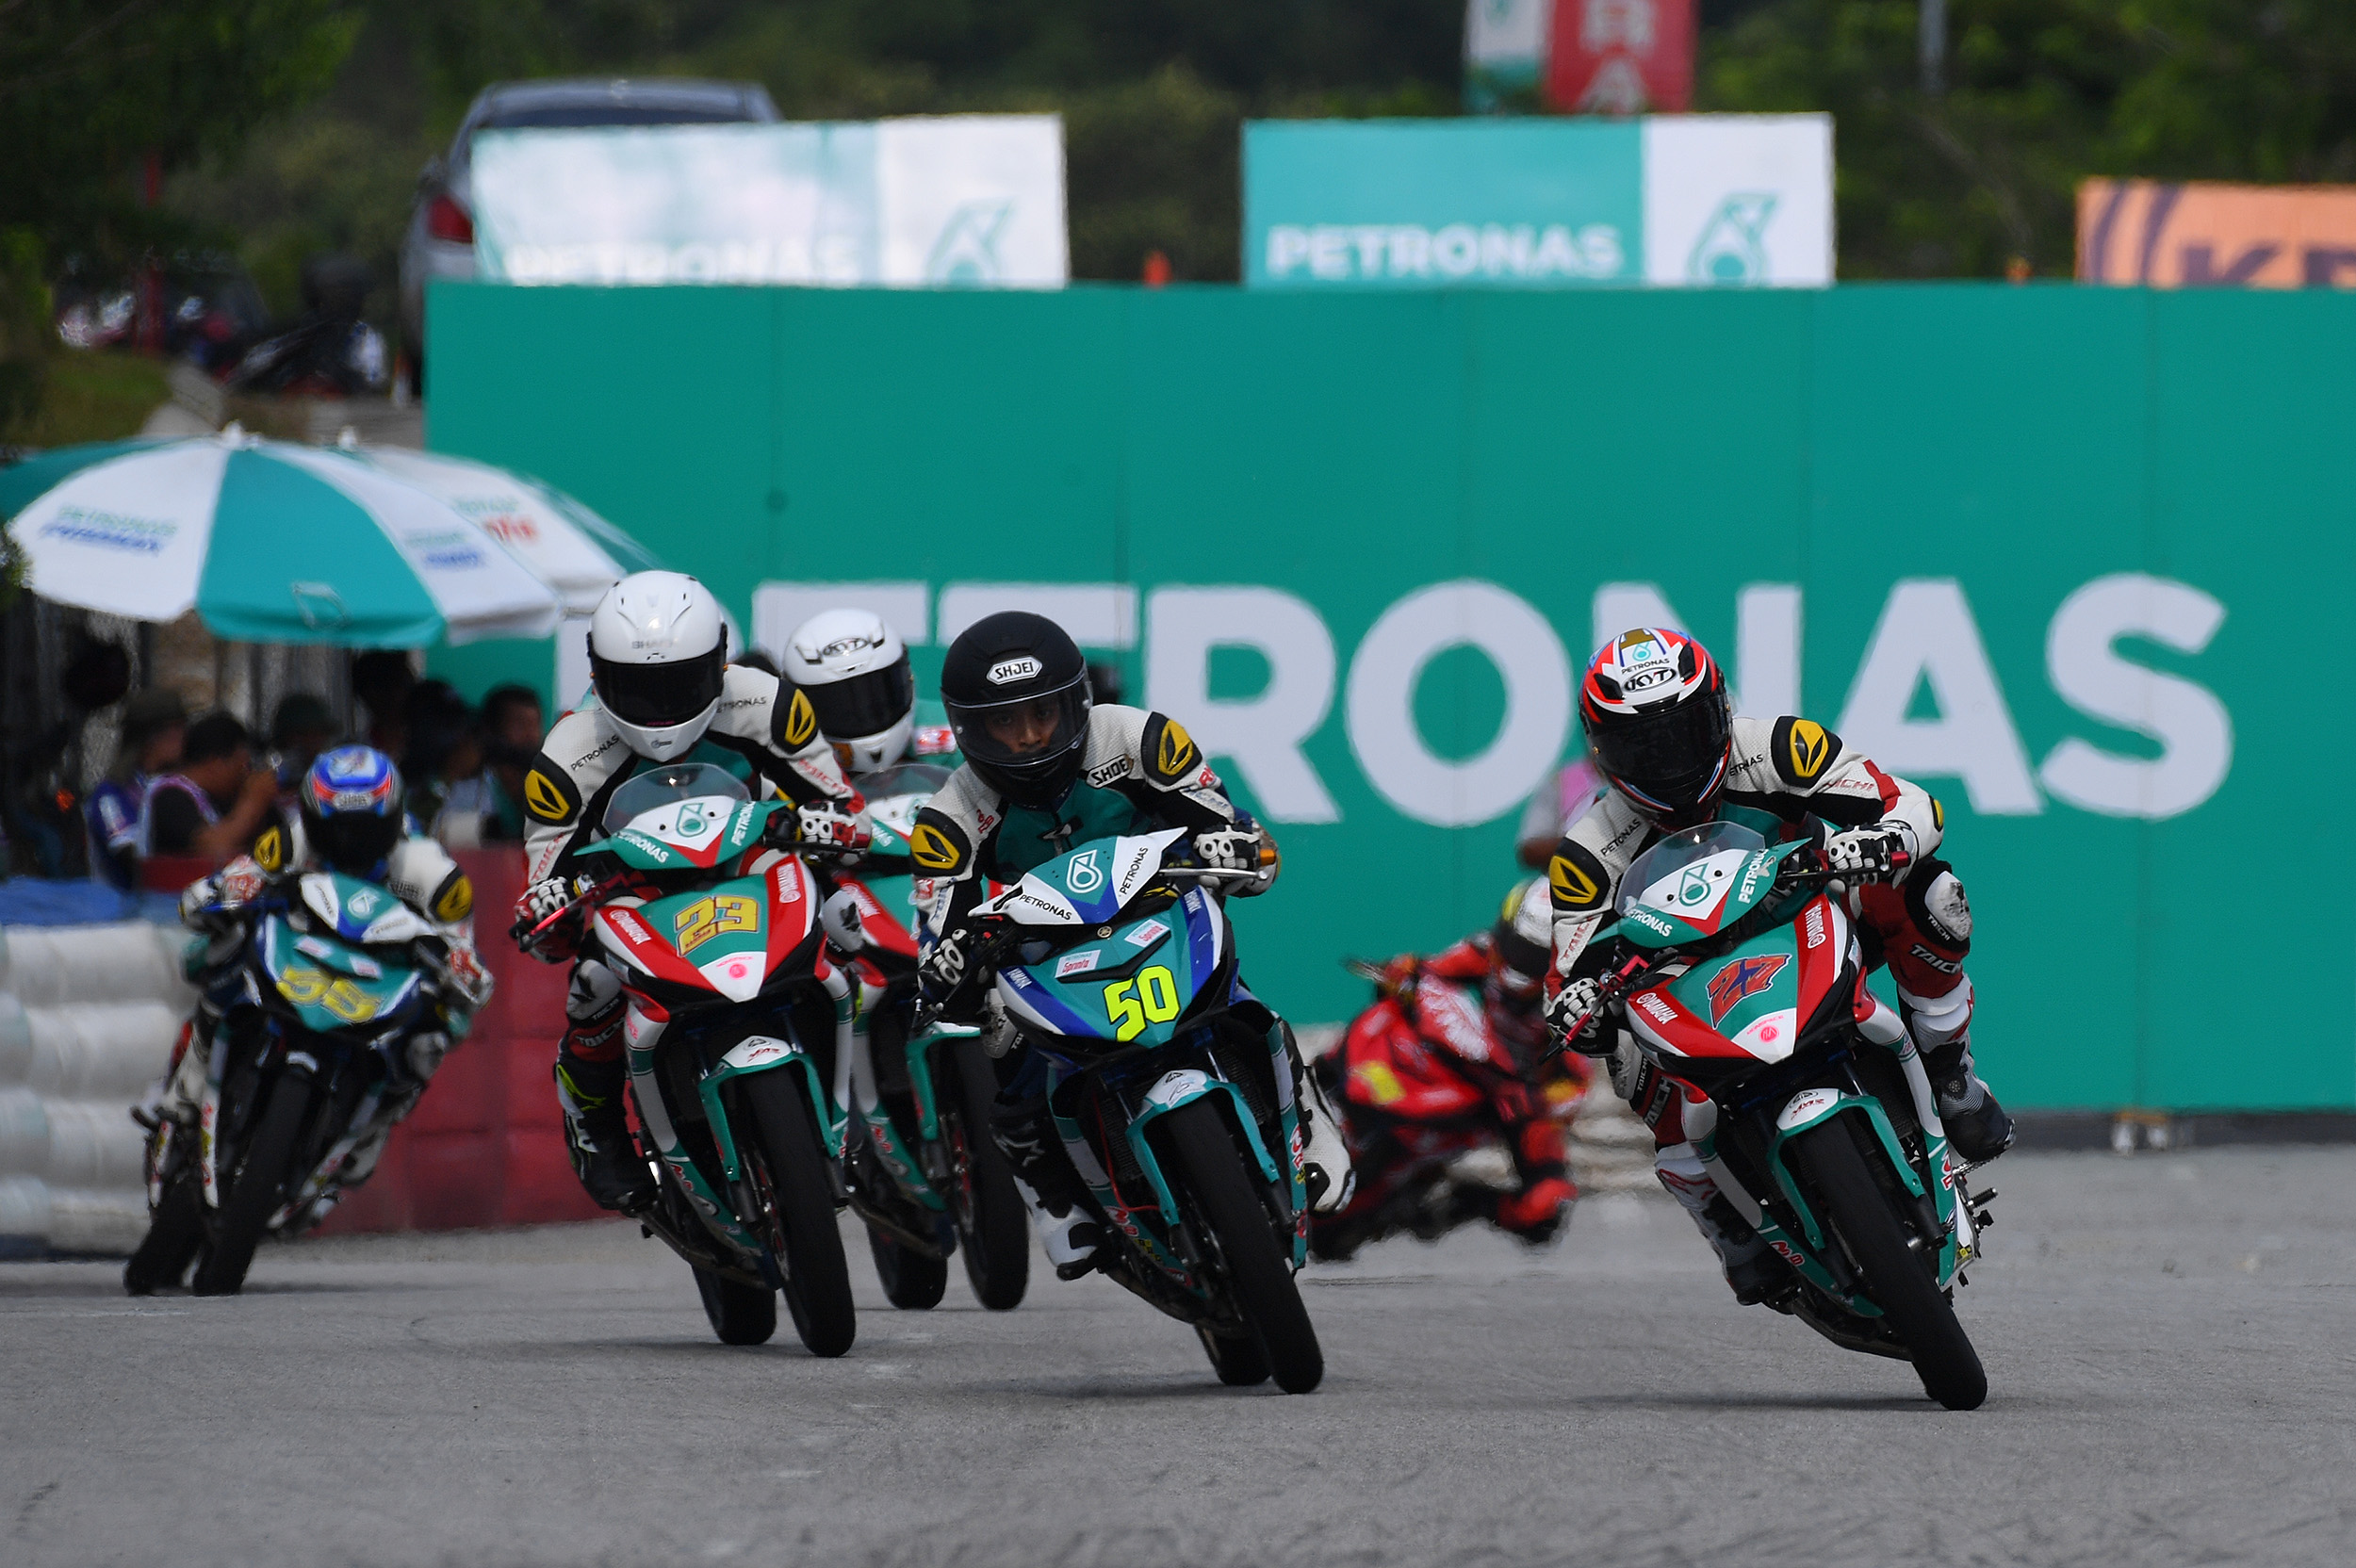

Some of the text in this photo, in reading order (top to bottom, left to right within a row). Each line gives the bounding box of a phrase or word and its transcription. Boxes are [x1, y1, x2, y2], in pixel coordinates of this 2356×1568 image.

[1267, 224, 1623, 277] PETRONAS
[995, 662, 1035, 680] SHOEI
[1621, 658, 1671, 675] PETRONAS
[1627, 667, 1670, 691] KYT
[556, 571, 2233, 827] TRONAS
[717, 696, 767, 713] ETRONAS
[570, 734, 620, 772] PETRONAS
[1090, 758, 1131, 786] SHOE
[730, 800, 756, 846] PETRONA
[1120, 847, 1149, 895] PETRONAS
[1738, 848, 1769, 904] PETRONA
[675, 895, 760, 956] 23
[1020, 894, 1072, 921] PETRONAS
[1805, 903, 1825, 940] YAMAHA
[1927, 913, 1951, 940] TAICHI
[1103, 965, 1181, 1042] 50
[1706, 954, 1792, 1030] 27
[1644, 998, 1678, 1024] YAMAHA
